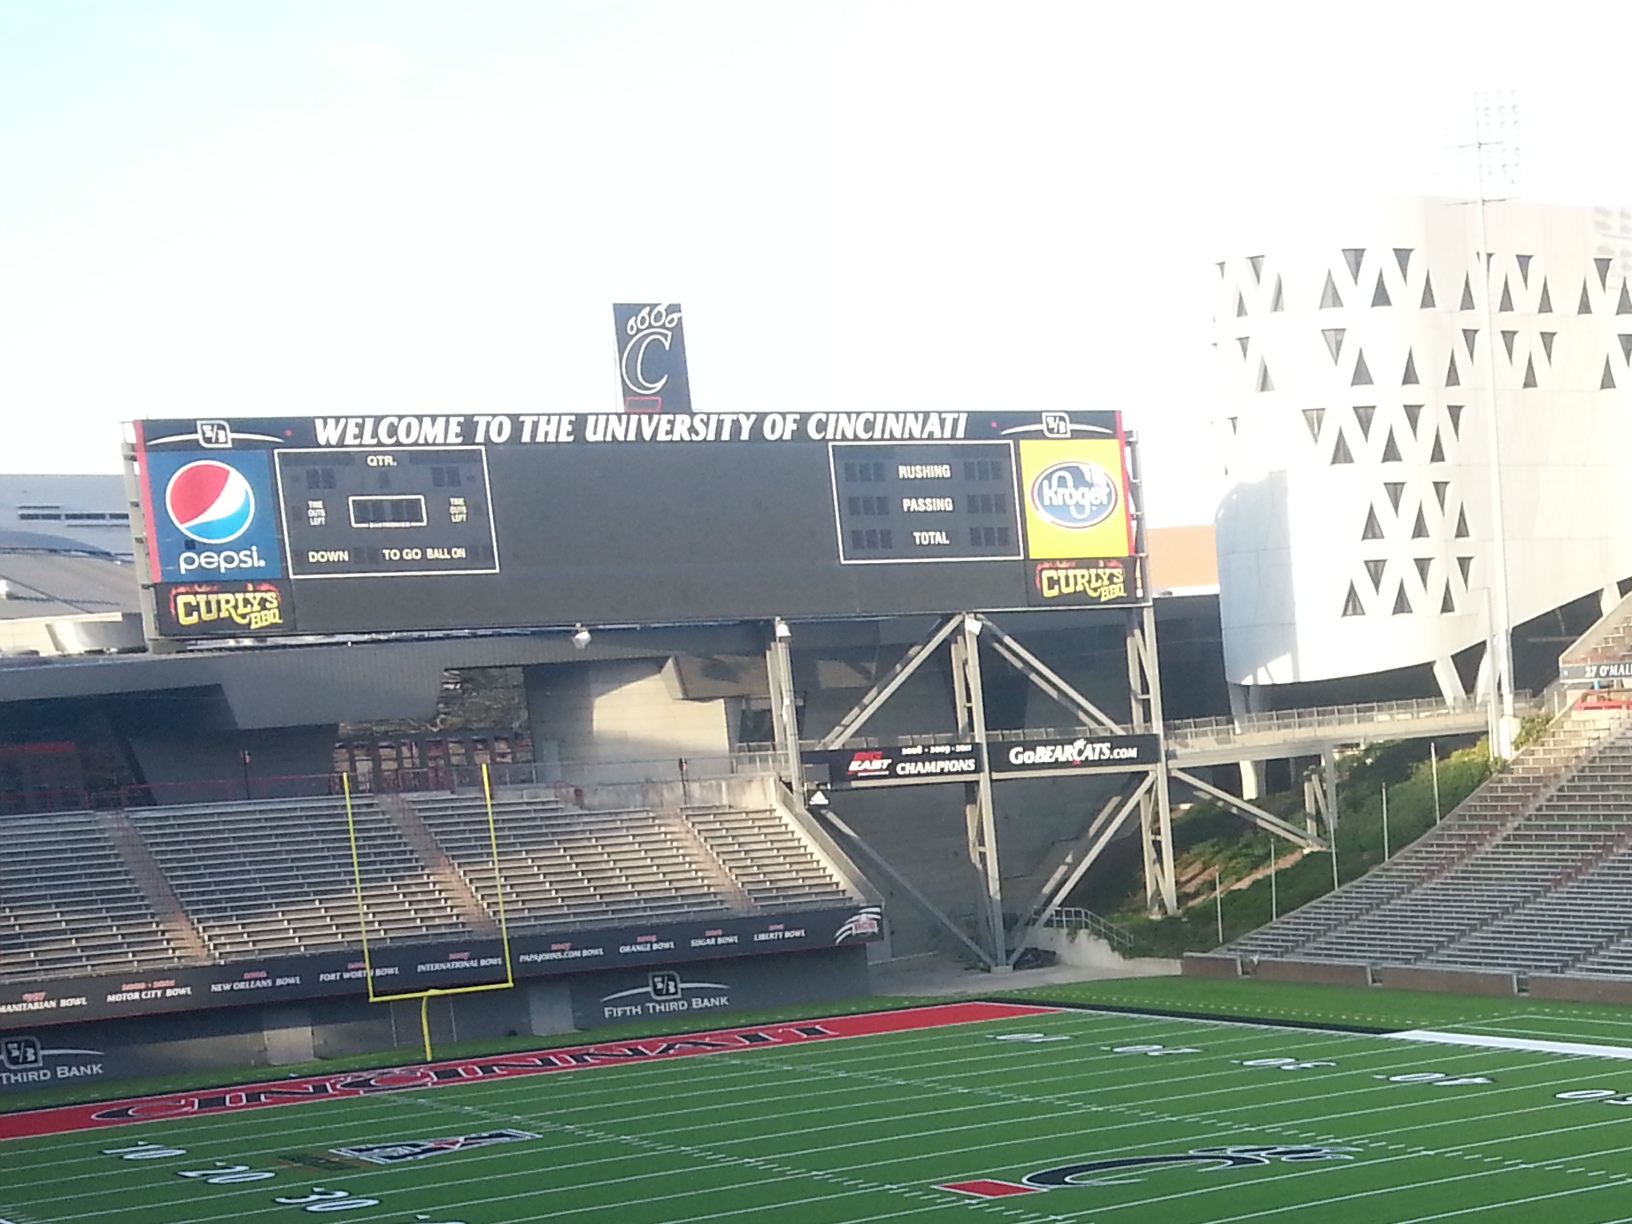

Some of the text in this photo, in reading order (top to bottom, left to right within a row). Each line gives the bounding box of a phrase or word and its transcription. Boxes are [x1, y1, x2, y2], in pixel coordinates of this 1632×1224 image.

[314, 412, 968, 445] WELCOME TO THE UNIVERSITY OF CINCINNATI
[367, 455, 397, 467] QTR.
[899, 465, 951, 479] RUSHING
[1042, 470, 1111, 519] Kroger
[903, 498, 953, 512] PASSING
[913, 531, 950, 545] TOTAL
[308, 548, 466, 563] DOWN TO GO BALL ON
[1042, 568, 1124, 598] CURLY'S
[1100, 584, 1127, 602] BBQ
[177, 592, 280, 626] CURLY'S
[250, 608, 283, 630] BBQ
[848, 759, 893, 771] EAST
[896, 759, 976, 775] CHAMPIONS
[691, 935, 739, 948] SUGAR BOWL
[754, 931, 784, 941] LIBERTY
[784, 928, 806, 938] BOWL
[582, 948, 604, 957] BOWL
[619, 941, 675, 954] ORANGE BOWL
[417, 957, 502, 973] INTERNATIONAL BOWL
[319, 972, 341, 982] FORT
[375, 967, 400, 977] BOWL
[210, 976, 301, 992] NEW ORLEANS BOWL
[59, 997, 87, 1008] BOWL
[107, 987, 192, 1003] MOTOR CITY BOWL
[604, 996, 729, 1019] FIFTH THIRD BANK
[0, 1063, 103, 1085] THIRD BANK
[92, 1024, 840, 1121] CINCINNATI
[177, 1164, 277, 1185] 20
[275, 1188, 380, 1213] 30
